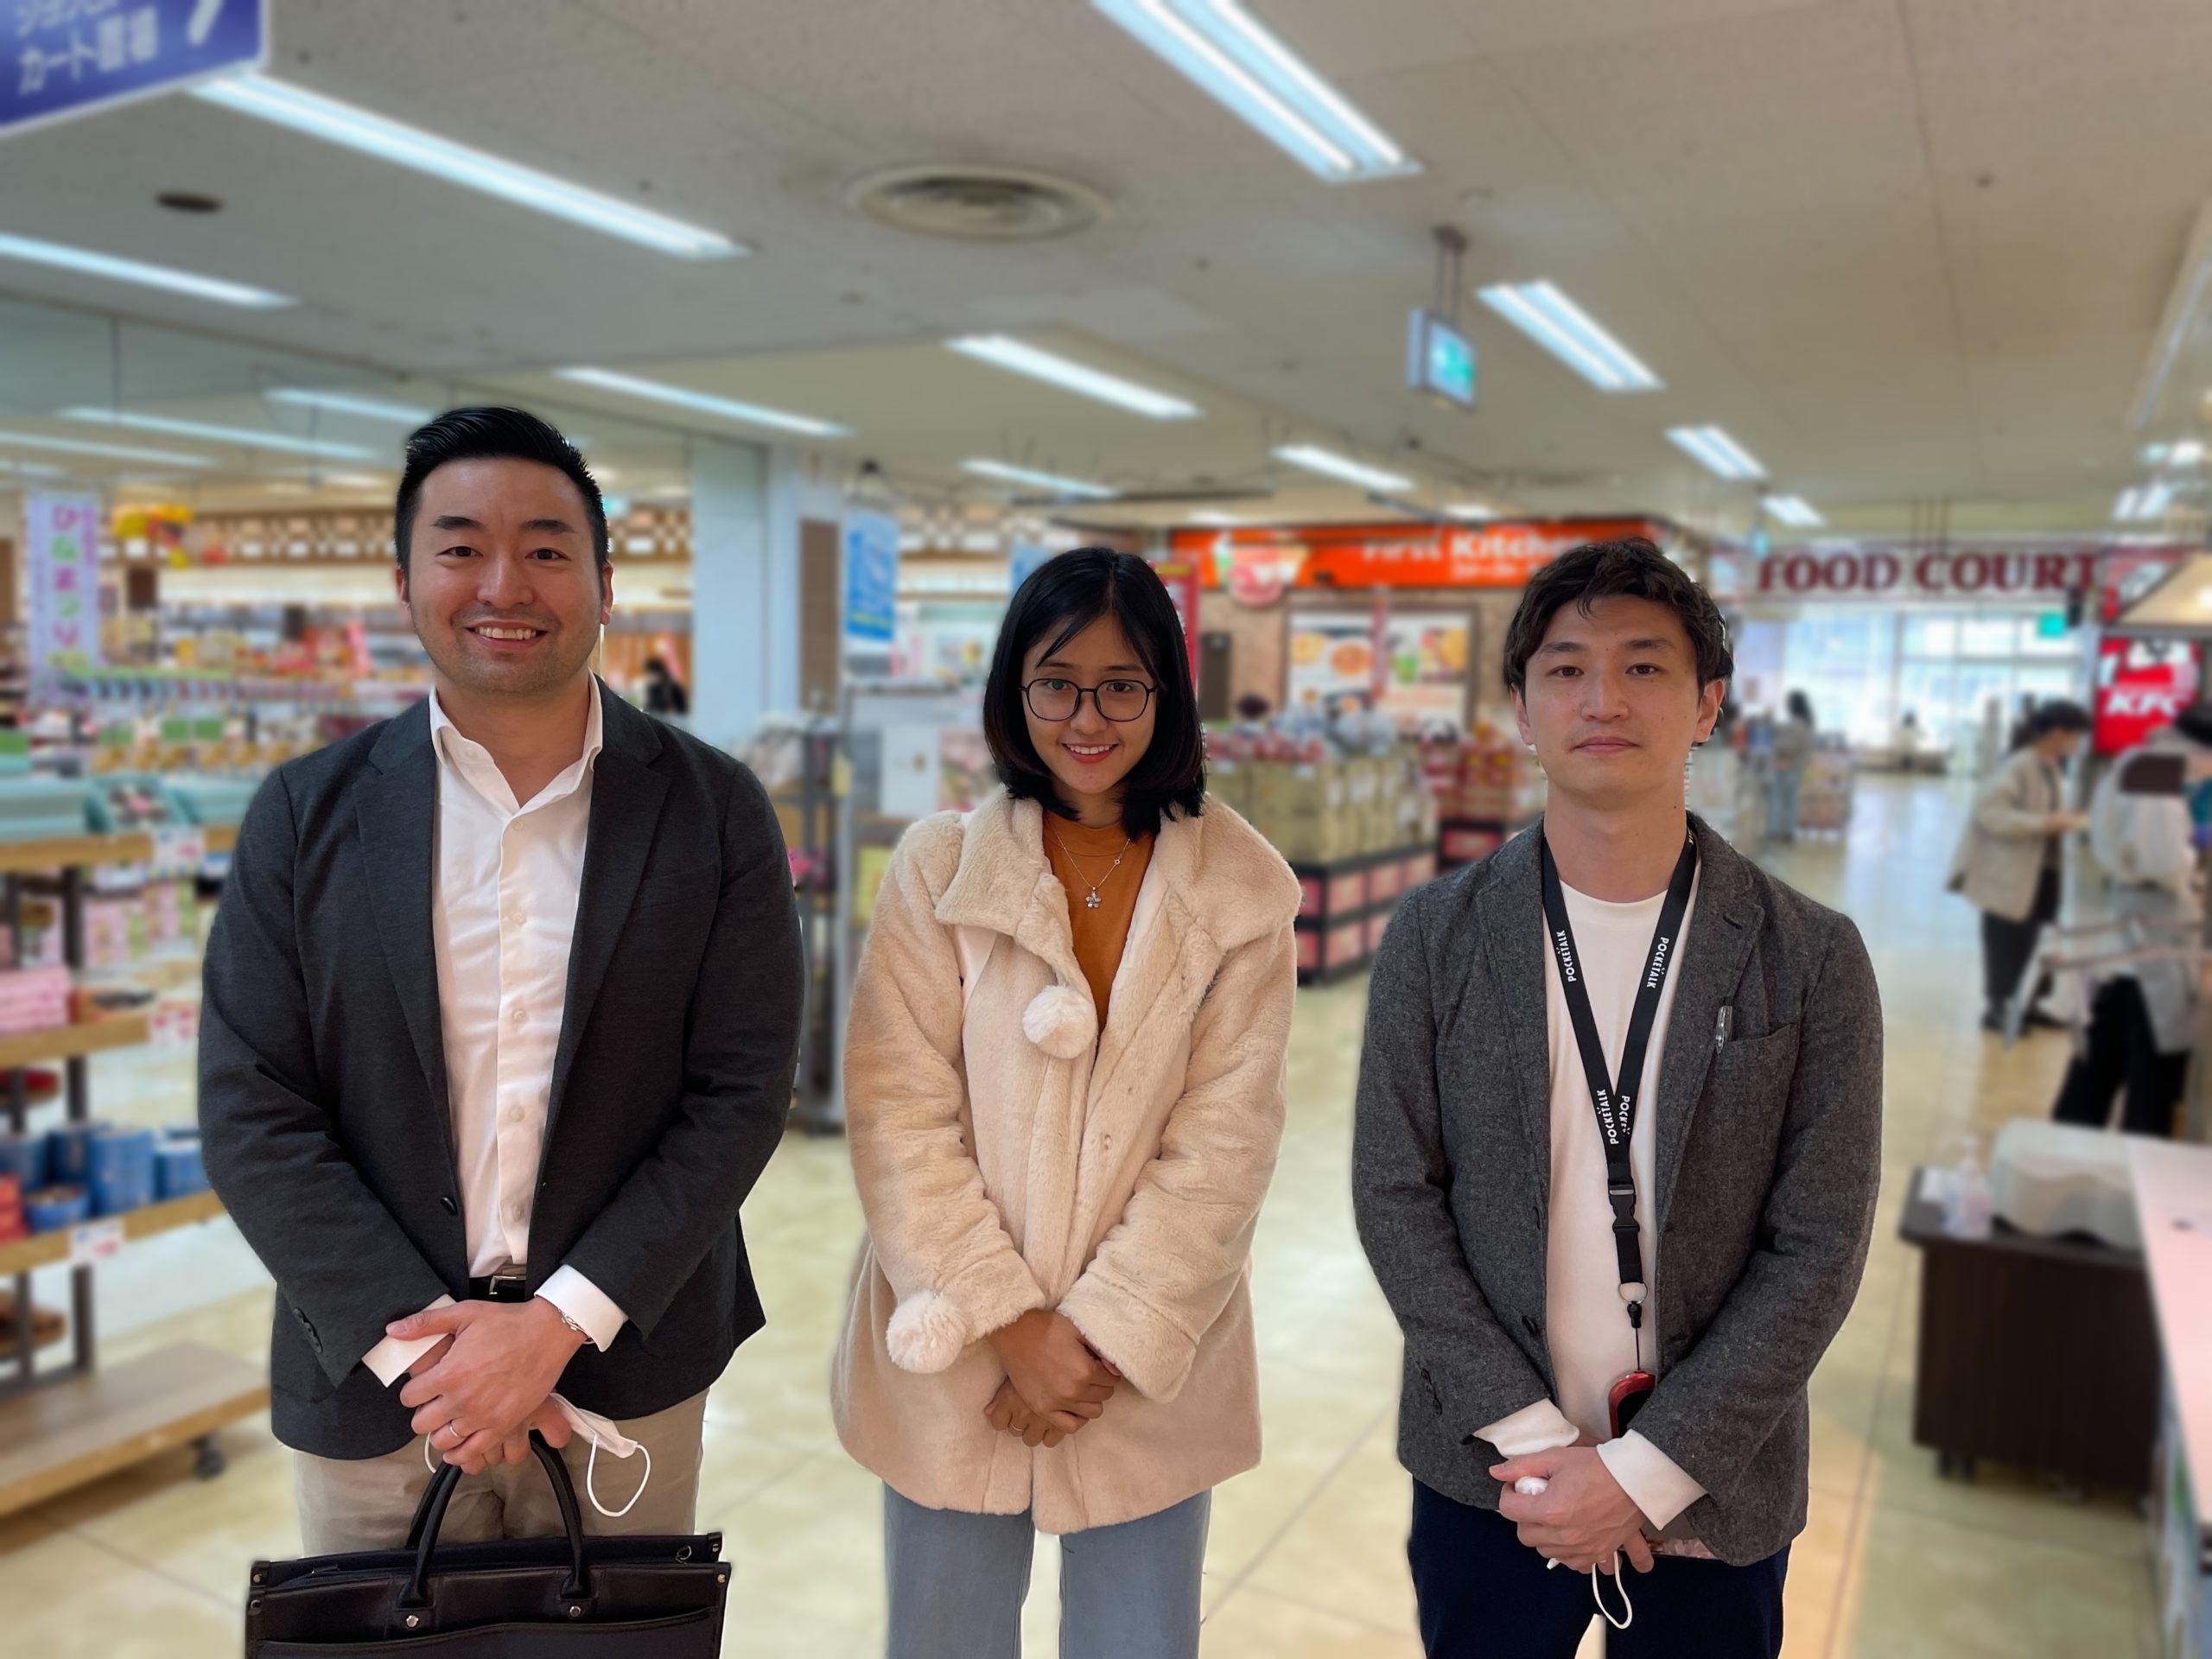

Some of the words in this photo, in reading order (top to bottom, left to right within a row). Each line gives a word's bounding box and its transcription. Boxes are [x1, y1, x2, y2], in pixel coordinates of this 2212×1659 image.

[1758, 552, 1901, 592] FOOD
[1913, 551, 2098, 592] COURT
[1556, 931, 1576, 982] POCKETALK
[1647, 938, 1669, 988] POCKETALK
[1597, 1090, 1619, 1144] POCKETALK
